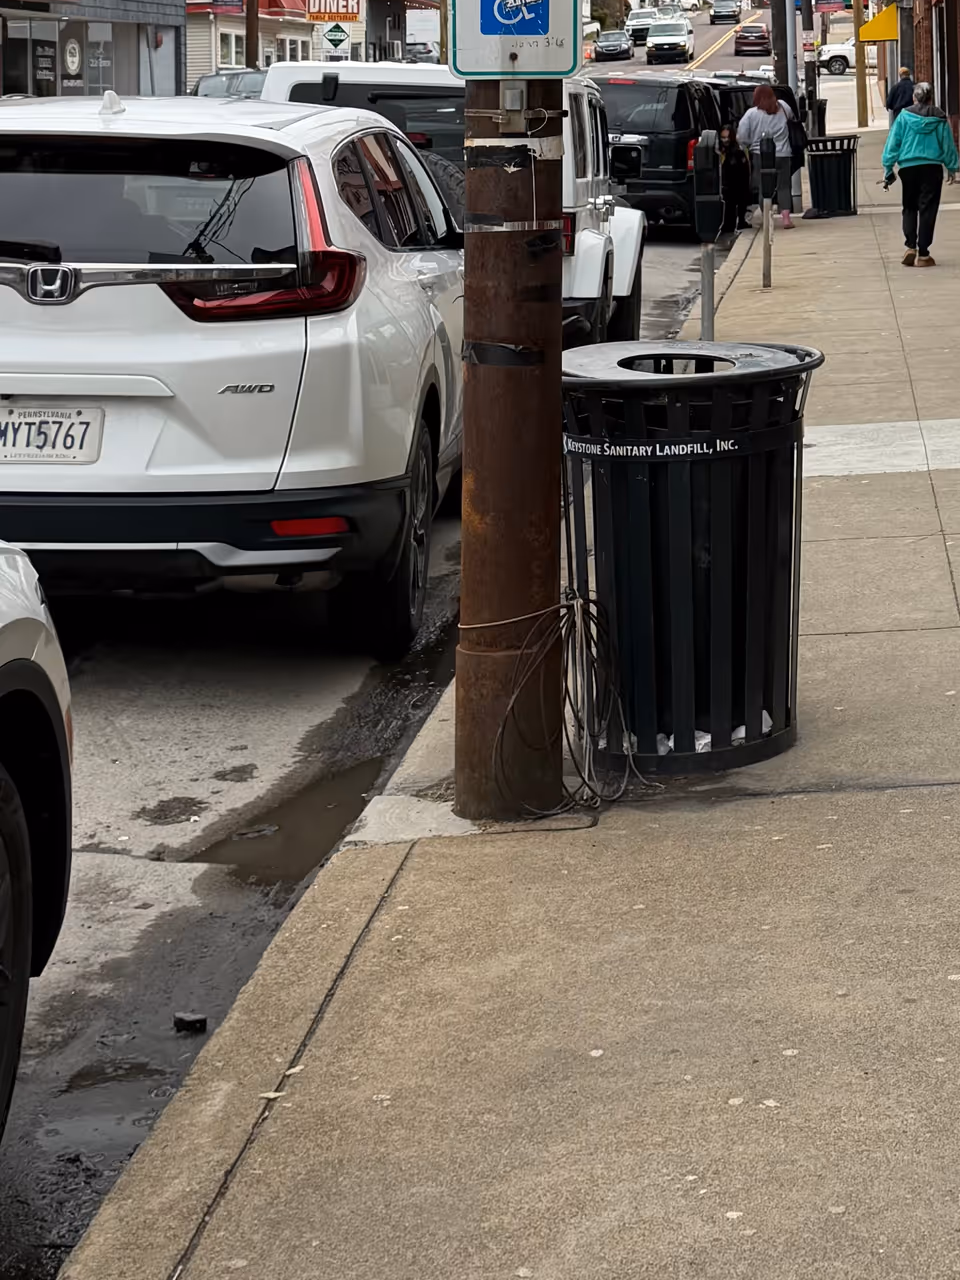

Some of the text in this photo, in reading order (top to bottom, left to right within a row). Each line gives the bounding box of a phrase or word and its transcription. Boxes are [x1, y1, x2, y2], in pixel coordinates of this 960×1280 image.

[217, 382, 275, 395] AWD
[17, 410, 72, 420] PENNSYLVANIA
[568, 438, 738, 456] KEYSTONE SANITARY LANDFILL, INC.
